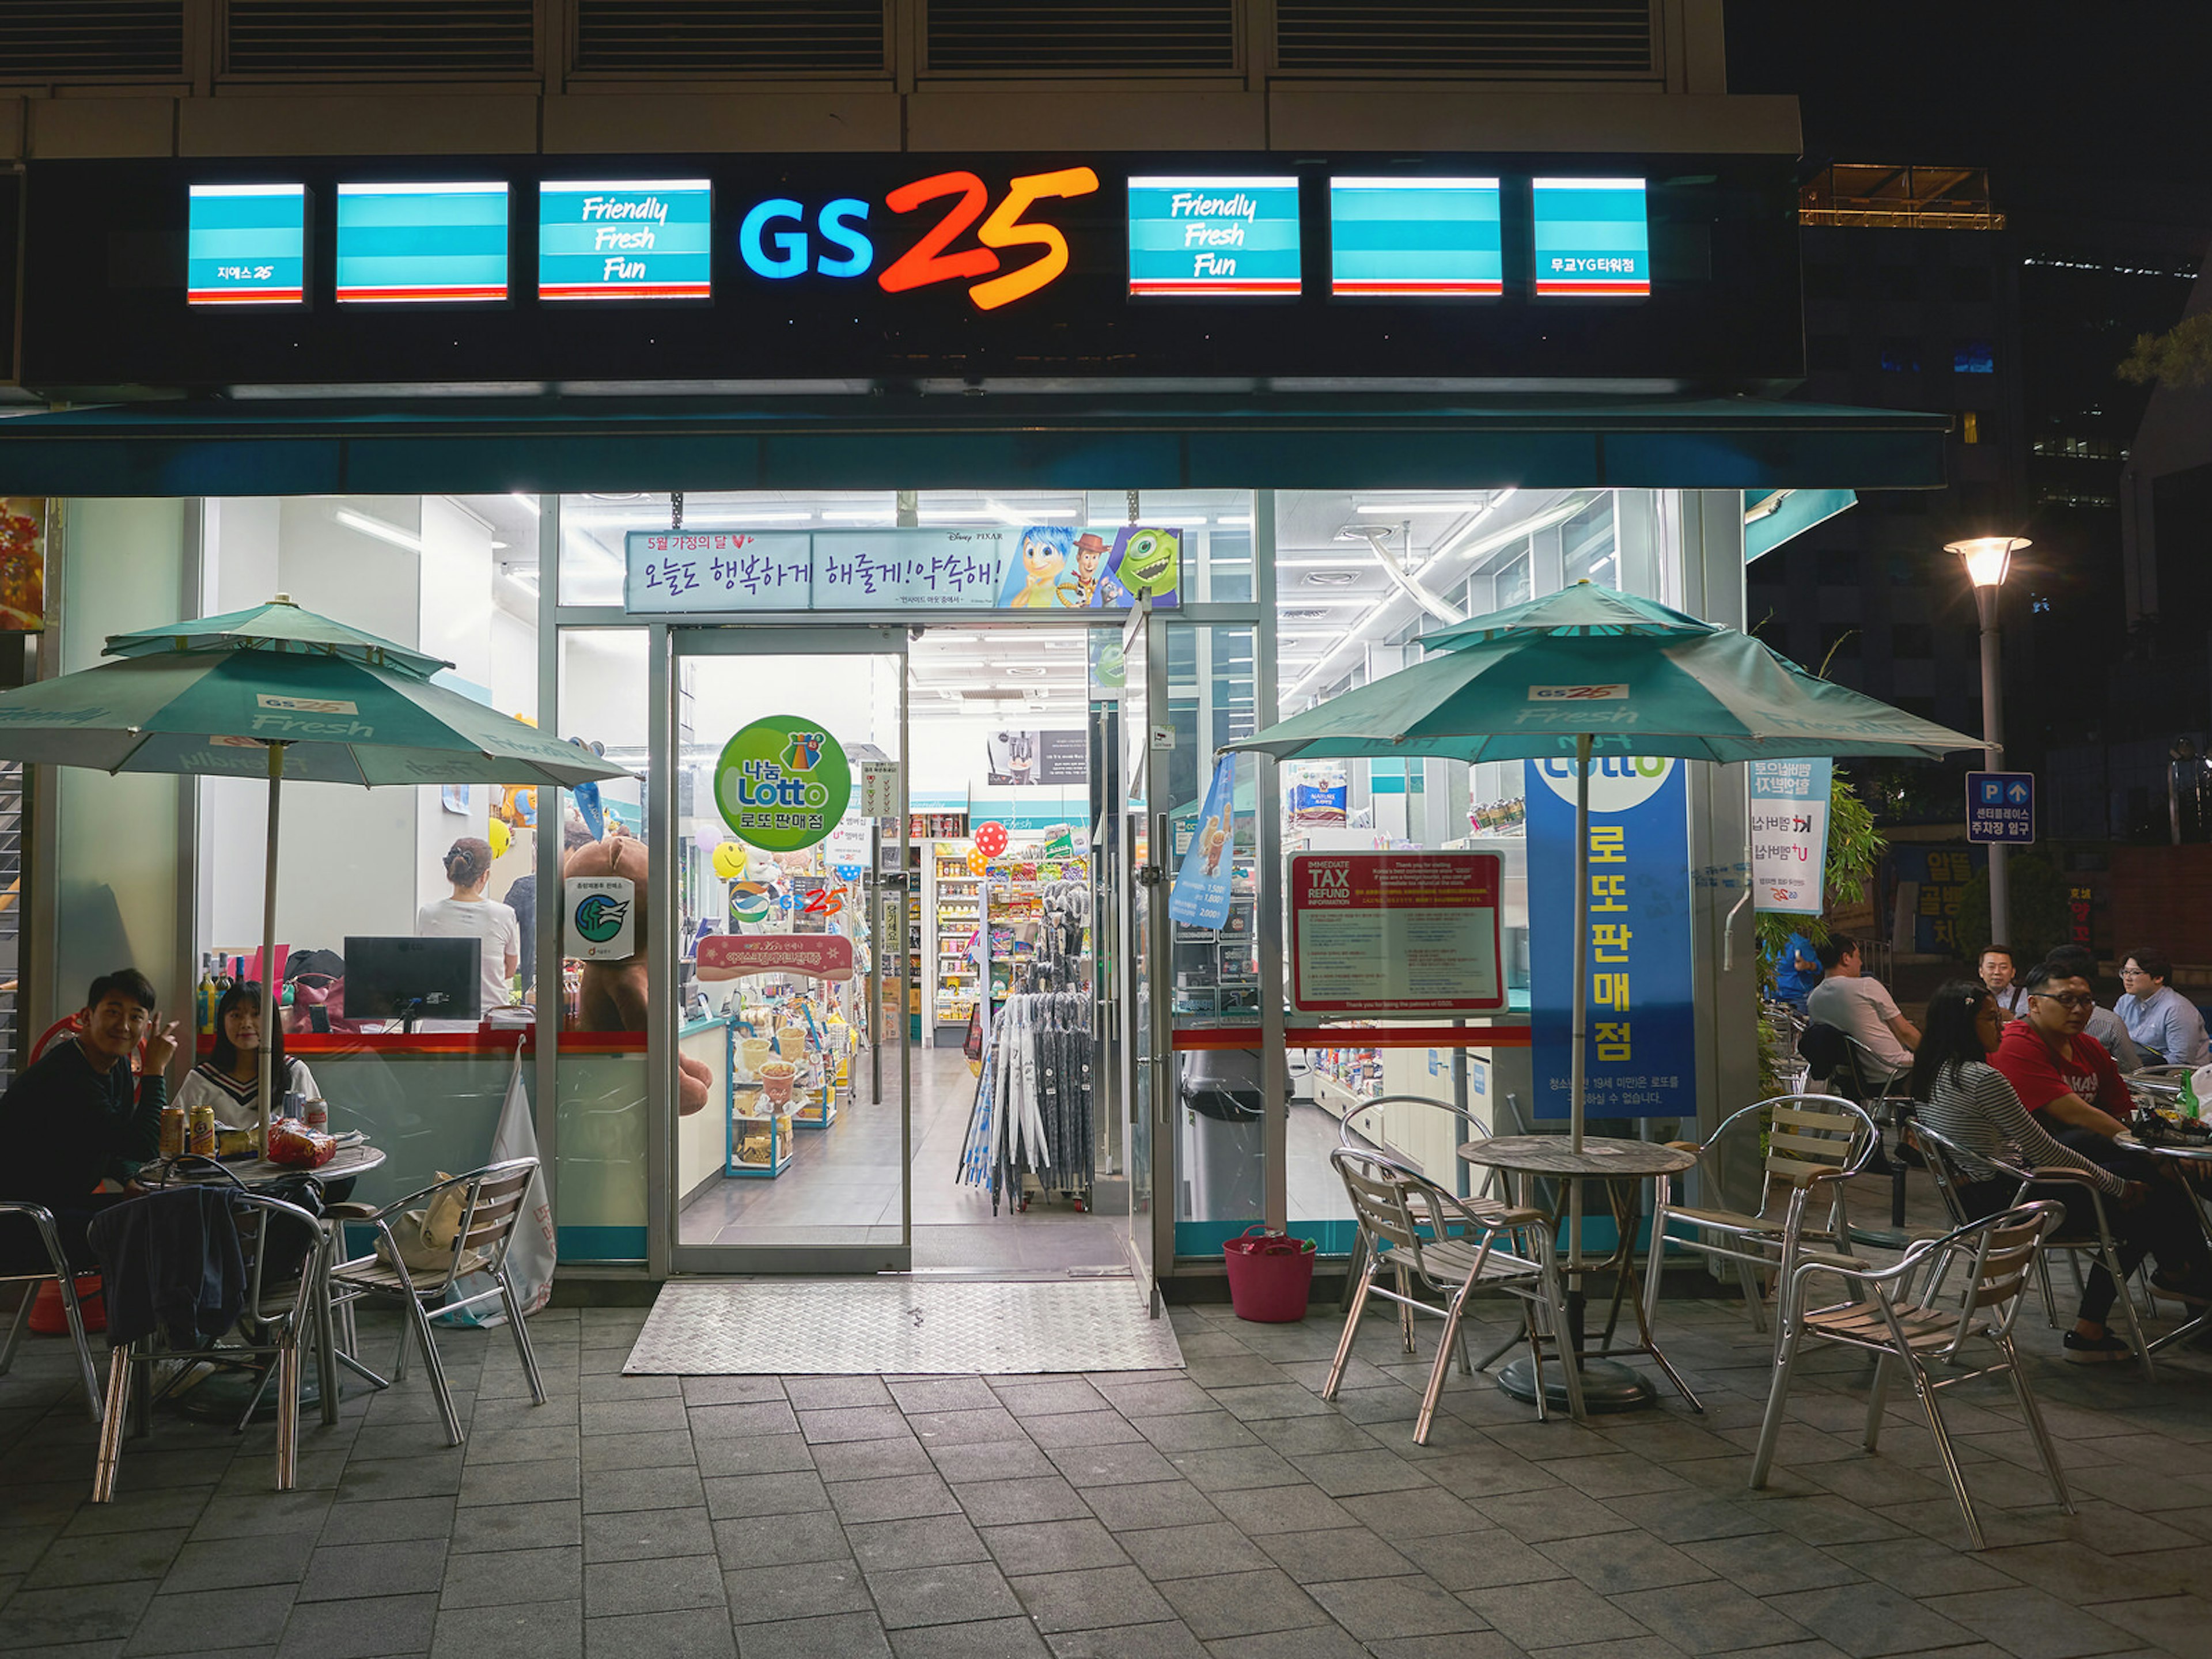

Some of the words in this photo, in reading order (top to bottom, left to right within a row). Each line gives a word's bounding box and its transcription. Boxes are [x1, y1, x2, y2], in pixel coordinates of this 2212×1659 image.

[582, 196, 668, 226] Friendly
[1171, 192, 1257, 224] Friendly
[595, 226, 655, 252] Fresh
[1184, 222, 1245, 249] Fresh
[218, 266, 252, 281] 지에스
[253, 266, 275, 280] 25
[603, 257, 646, 282] Fun
[1193, 252, 1236, 278] Fun
[1551, 257, 1635, 273] 무교YG타워점
[648, 537, 668, 551] 5월
[673, 536, 710, 551] 가정의
[714, 536, 727, 550] 달
[948, 532, 972, 543] Disney
[646, 557, 700, 596] 오늘도
[710, 554, 813, 595] 행복하게
[1537, 684, 1619, 699] GS25
[265, 699, 347, 713] GS25
[1515, 706, 1639, 724] Fresh
[252, 714, 374, 738] Fresh
[743, 761, 781, 780] 나눔
[738, 777, 830, 808] Lotto
[1986, 784, 1999, 800] P
[1972, 821, 2004, 836] 주차장
[2008, 821, 2029, 836] 입구
[1308, 861, 1350, 869] IMMEDIATE
[1308, 869, 1350, 887] TAX
[1308, 888, 1350, 898] REFUND
[779, 888, 848, 917] GS25
[1609, 1092, 1619, 1104] 수
